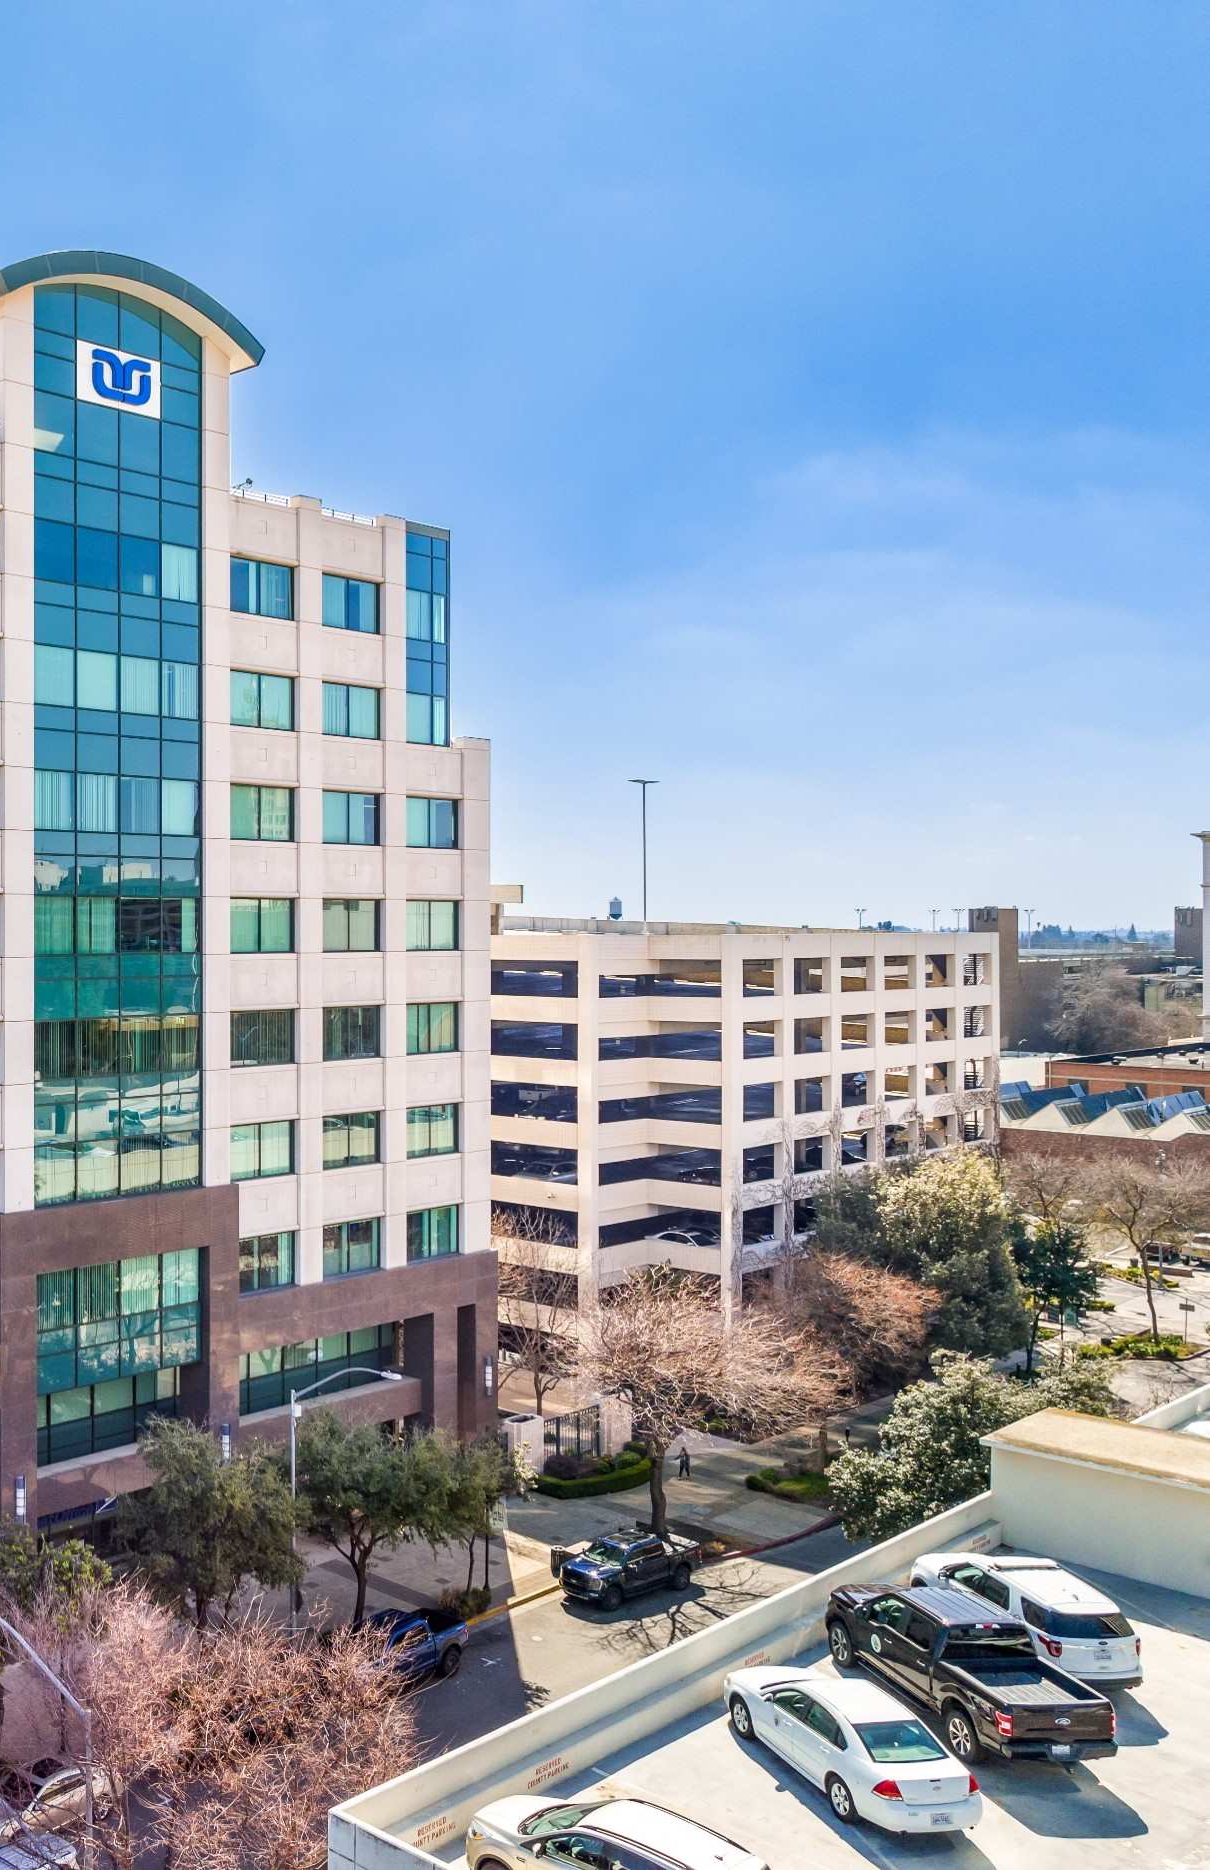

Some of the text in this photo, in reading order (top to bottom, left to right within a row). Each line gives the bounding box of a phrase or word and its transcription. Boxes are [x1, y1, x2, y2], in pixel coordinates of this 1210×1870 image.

[527, 1762, 570, 1789] COUNTY PARKING
[535, 1757, 562, 1776] RESERVED
[417, 1816, 447, 1837] RESERVED
[431, 1822, 456, 1841] PARKING
